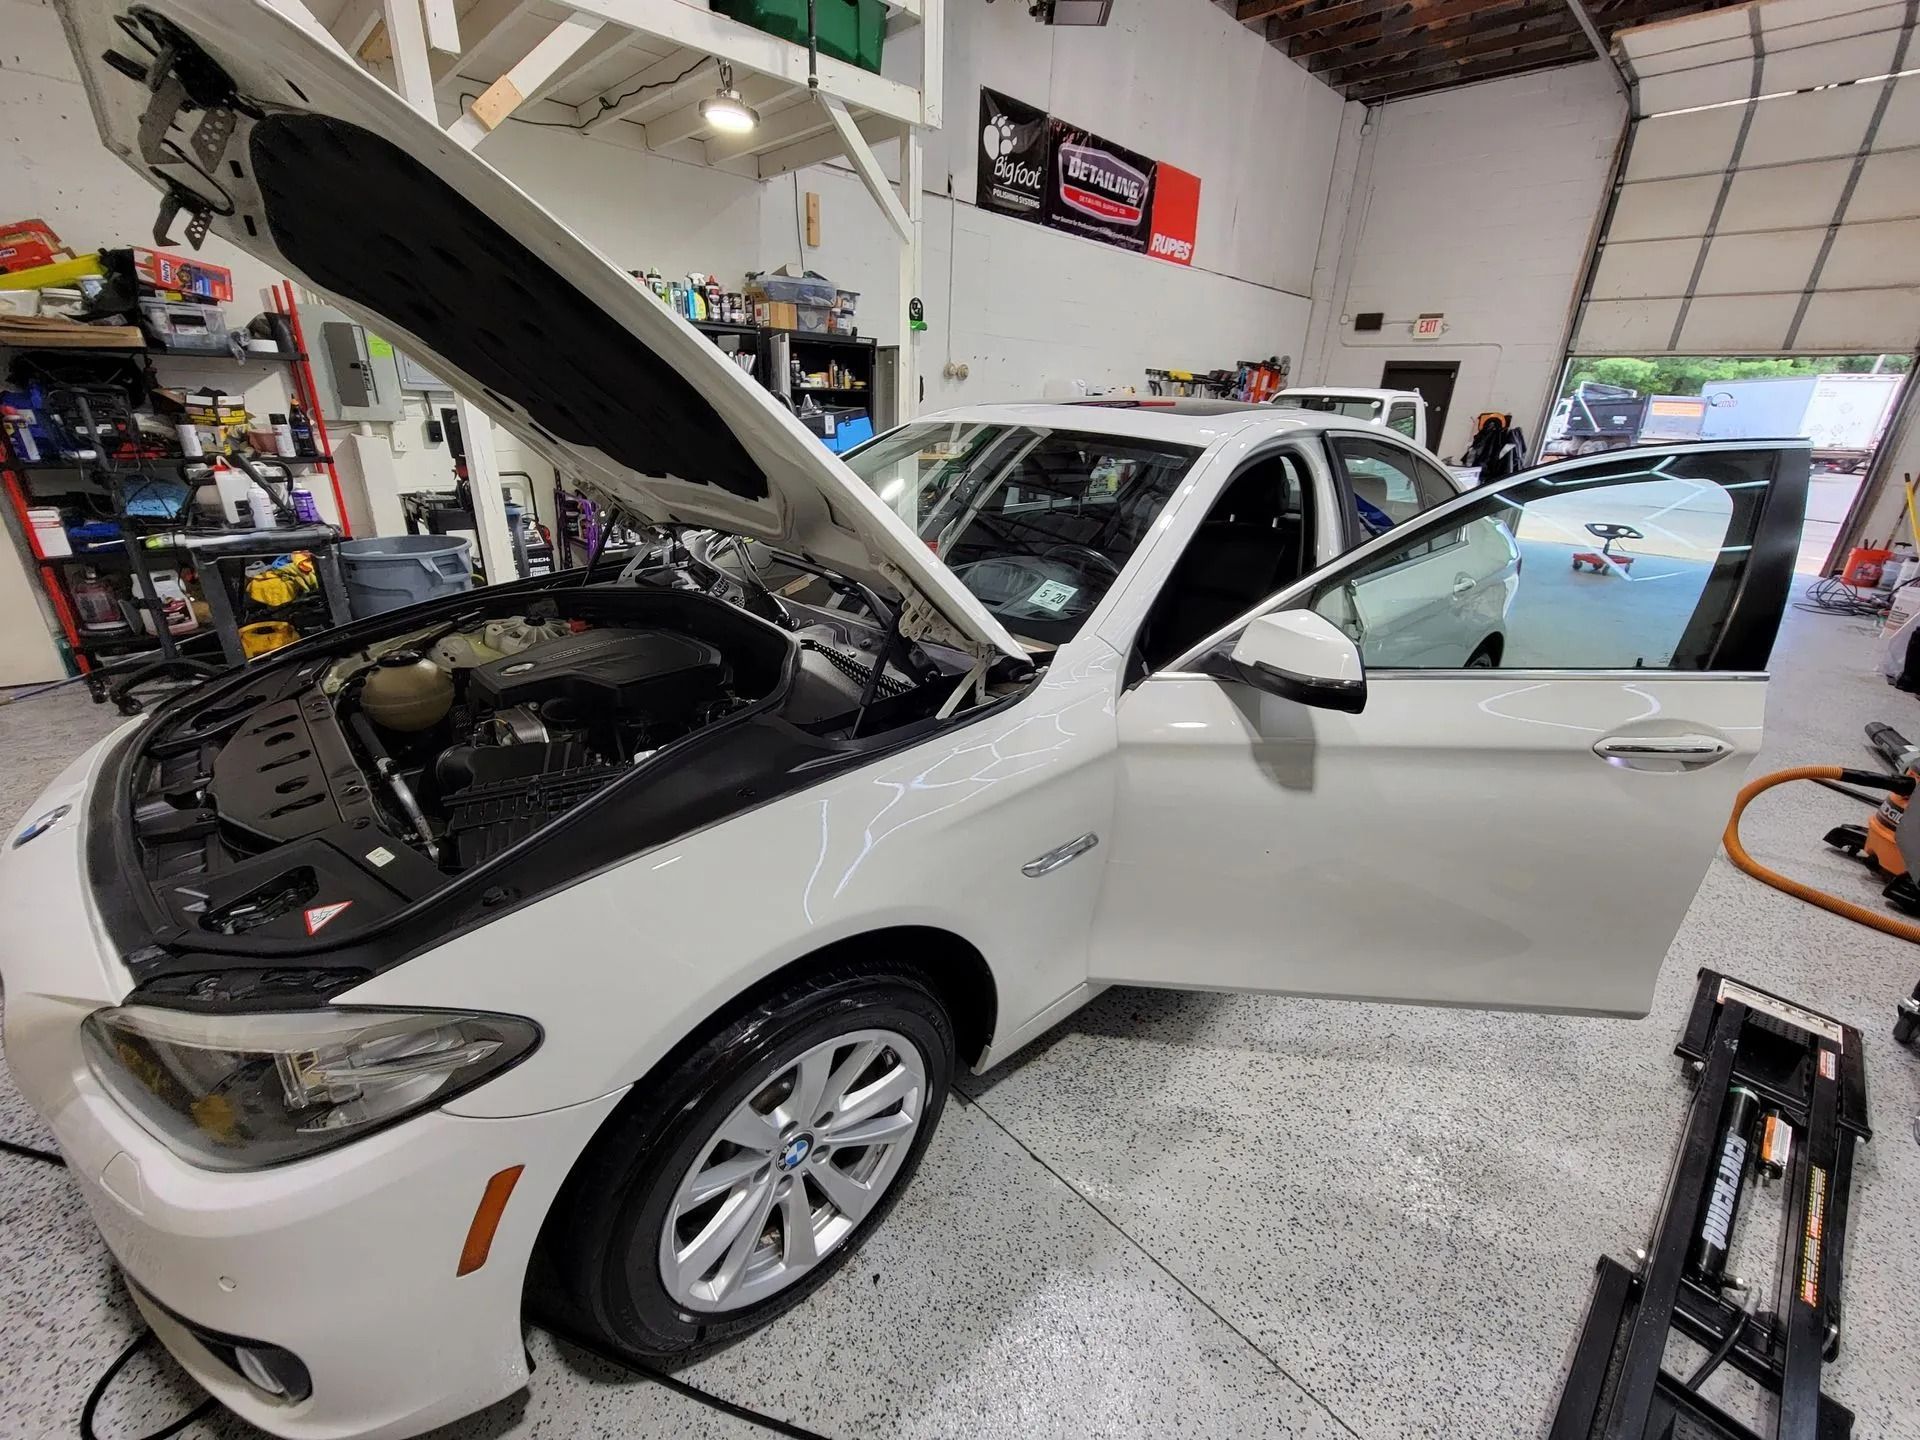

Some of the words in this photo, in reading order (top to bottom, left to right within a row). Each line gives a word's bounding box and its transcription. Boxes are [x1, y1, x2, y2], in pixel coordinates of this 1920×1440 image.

[1068, 155, 1139, 199] DETAILING
[1151, 233, 1192, 260] RUPES
[1419, 320, 1438, 333] EXIT
[1040, 590, 1050, 598] 5
[1050, 593, 1067, 604] 20
[1702, 1131, 1747, 1250] QUICKJACK
